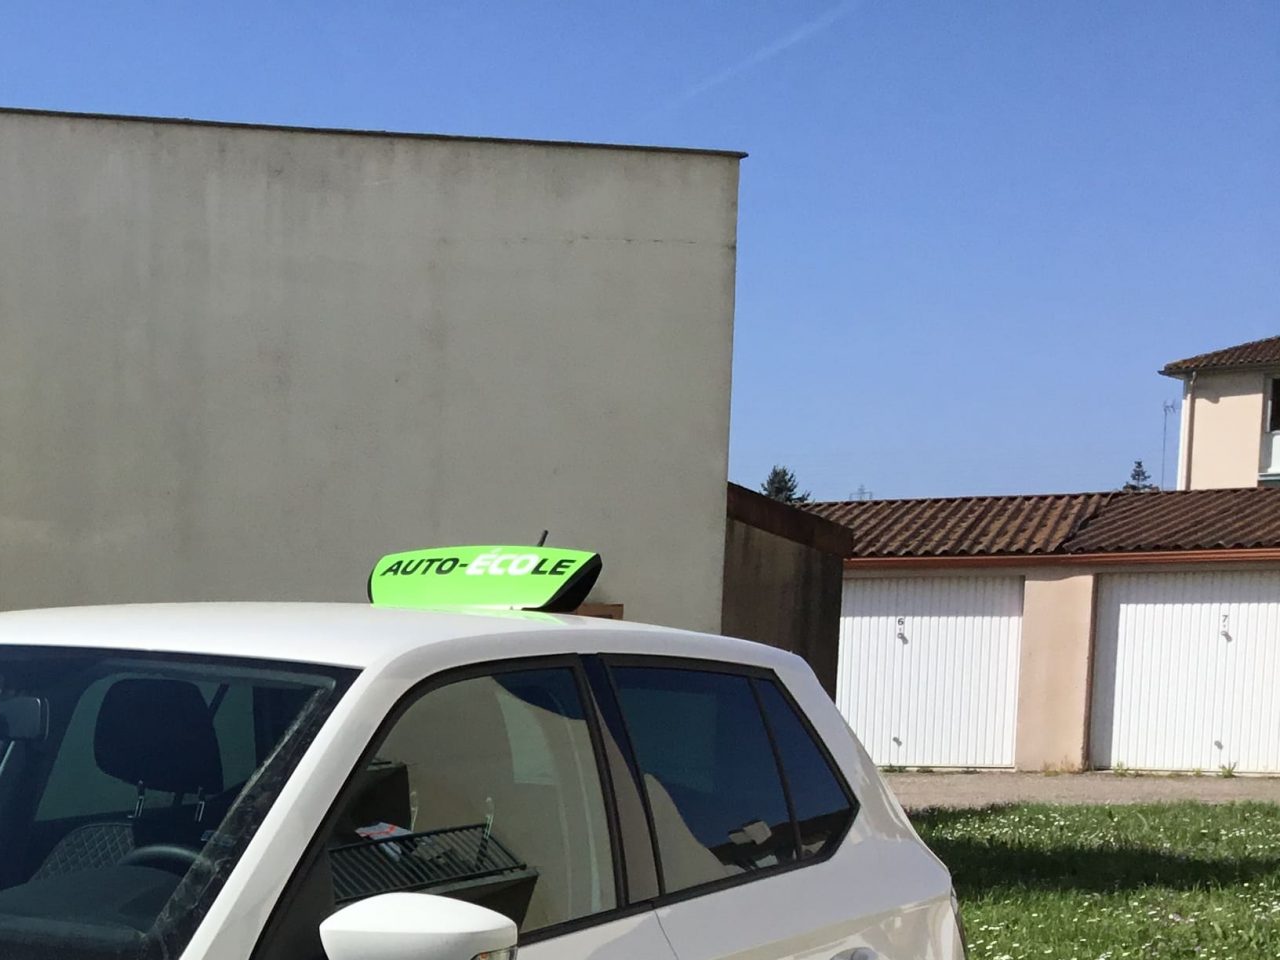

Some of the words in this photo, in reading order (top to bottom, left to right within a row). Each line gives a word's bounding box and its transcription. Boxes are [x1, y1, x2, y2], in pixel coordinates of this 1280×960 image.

[380, 548, 577, 577] AUTO-ÉCOLE
[897, 617, 904, 626] 6
[1222, 614, 1229, 623] 7
